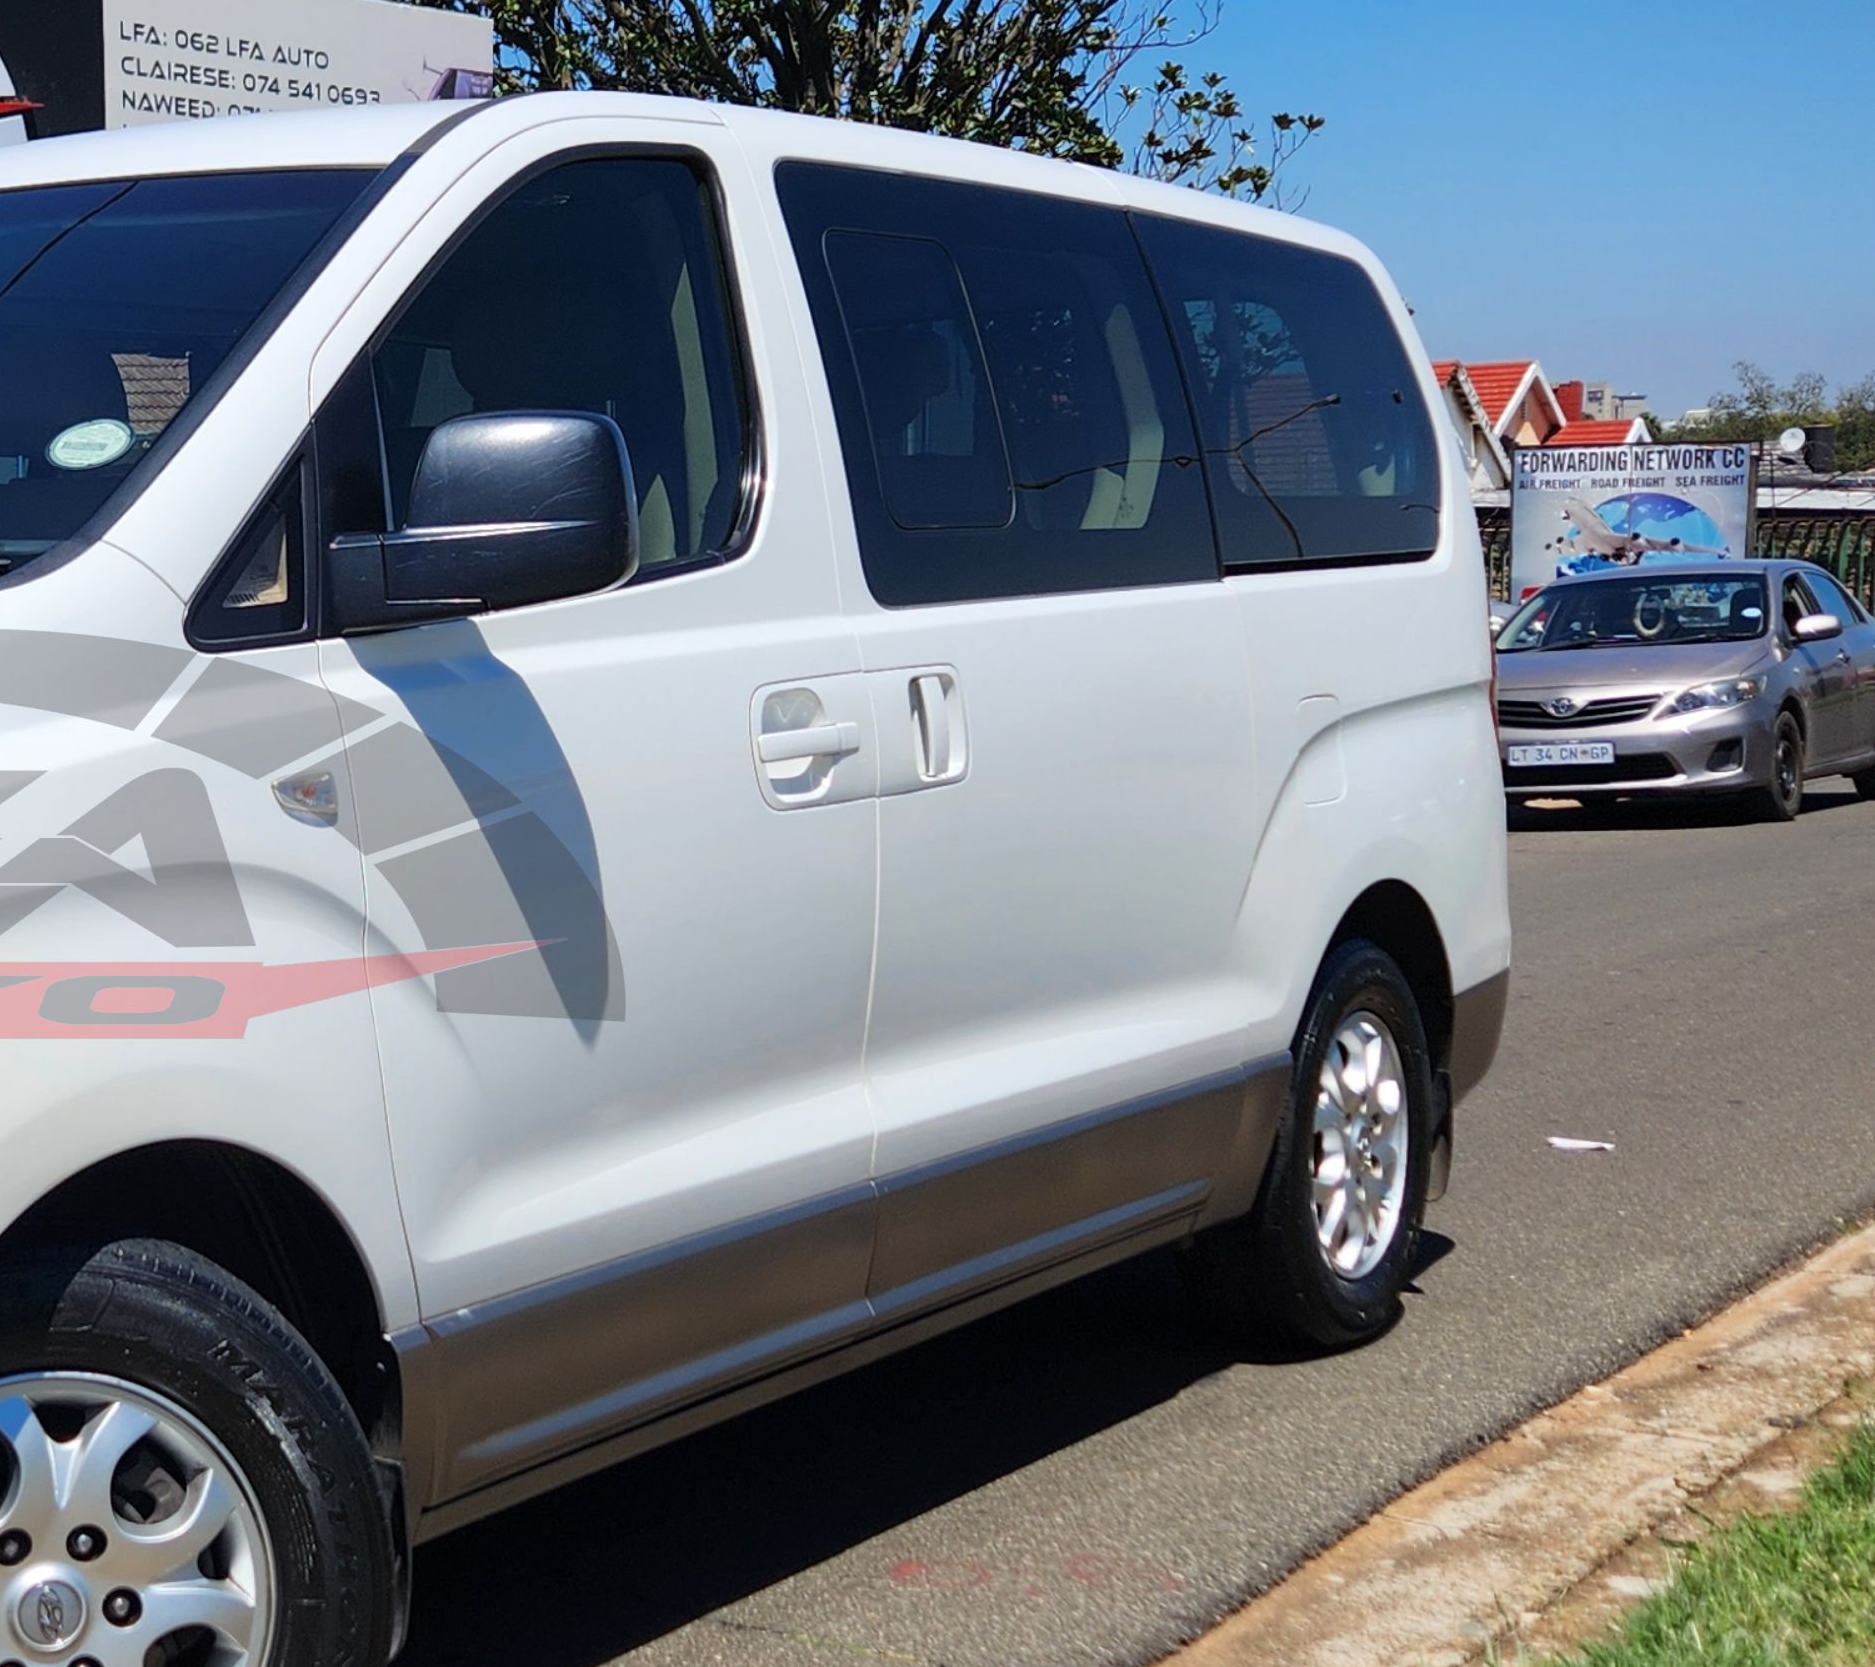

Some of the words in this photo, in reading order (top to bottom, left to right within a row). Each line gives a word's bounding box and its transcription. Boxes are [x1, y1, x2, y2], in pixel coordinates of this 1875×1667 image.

[120, 21, 167, 47] LFA:
[175, 30, 219, 53] 062
[226, 37, 265, 61] LFA
[272, 46, 329, 69] AUTO
[121, 56, 235, 90] CLAIRESE:
[242, 73, 280, 95] 074
[288, 79, 321, 102] 541
[1521, 451, 1626, 473] FORWARDING
[1633, 448, 1715, 472] NETWORK
[1722, 447, 1745, 469] CC
[1539, 479, 1581, 489] FREIGHT
[1591, 477, 1618, 488] ROAD
[1622, 476, 1666, 487] FREIGHT
[1675, 476, 1696, 487] SEA
[1700, 474, 1745, 486] FREIGHT
[1535, 747, 1553, 761] 34
[1559, 747, 1578, 760] CN
[1590, 746, 1609, 759] GP
